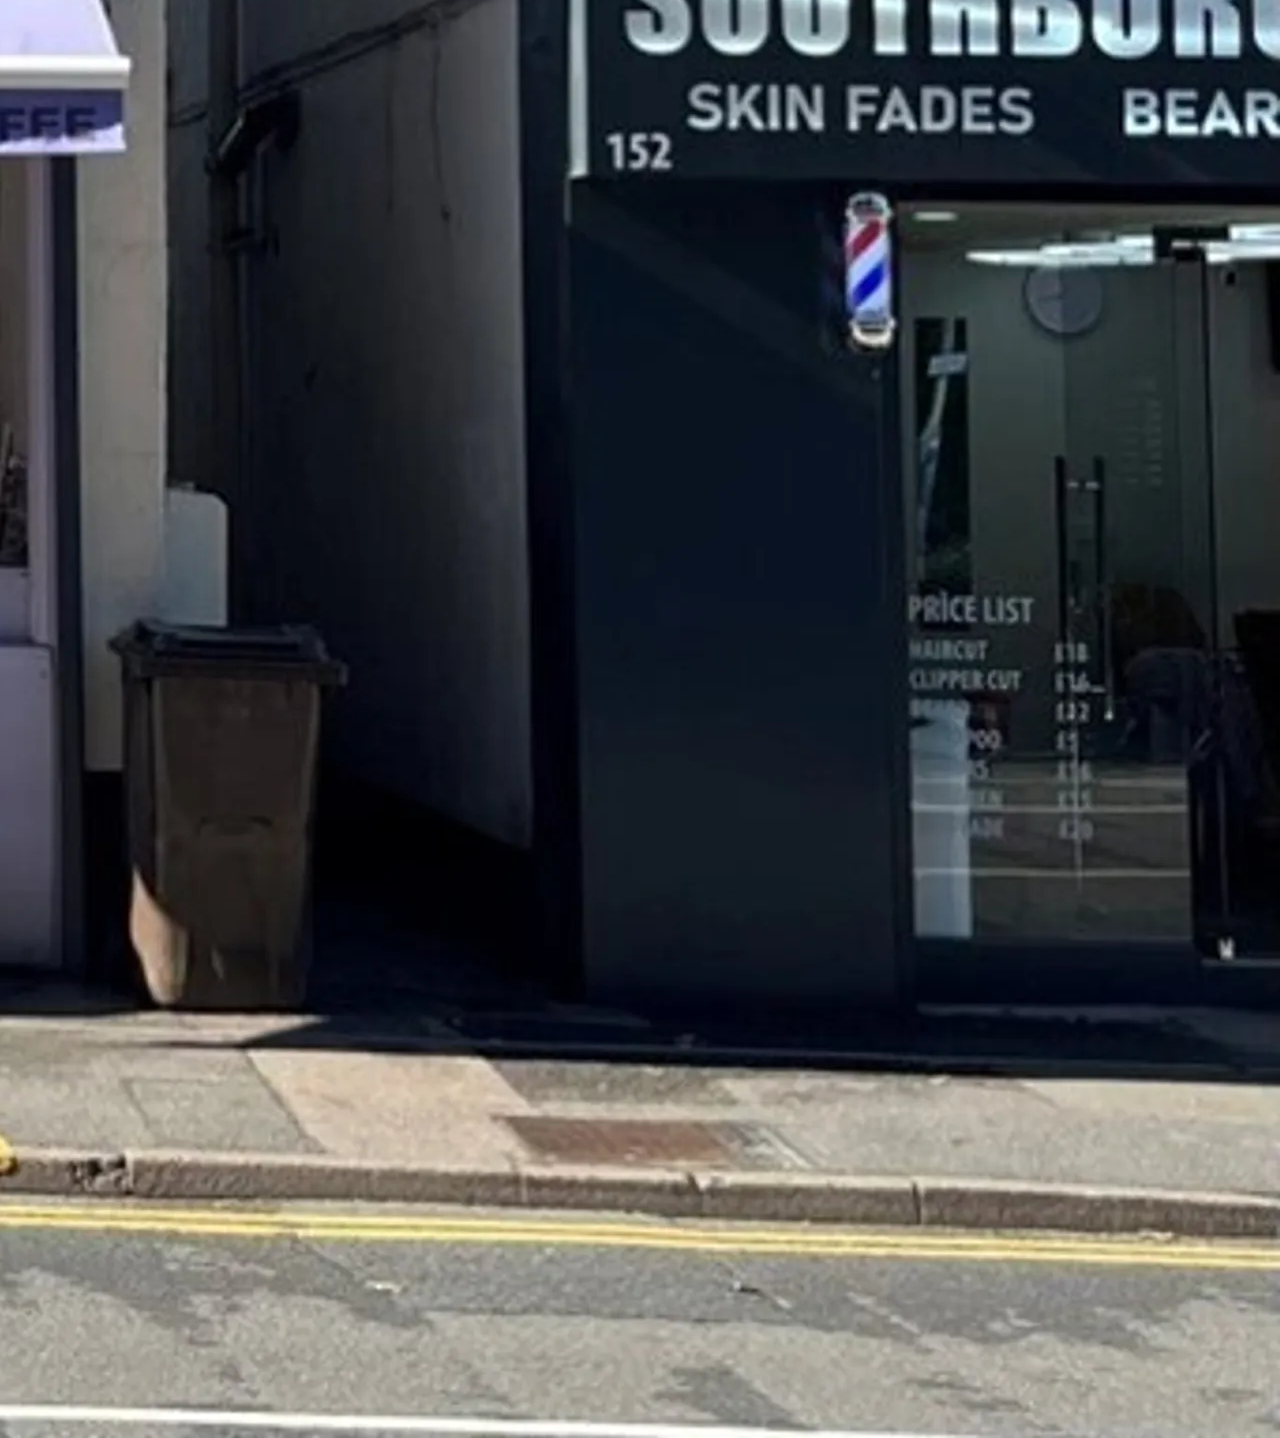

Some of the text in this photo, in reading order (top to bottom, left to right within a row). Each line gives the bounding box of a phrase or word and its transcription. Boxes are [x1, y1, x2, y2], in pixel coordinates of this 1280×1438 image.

[686, 84, 1034, 134] SKIN FADES
[607, 133, 672, 170] 152
[908, 591, 1035, 624] PRICE LIST
[909, 639, 988, 660] HAIRCUT
[987, 670, 1022, 691] CUT
